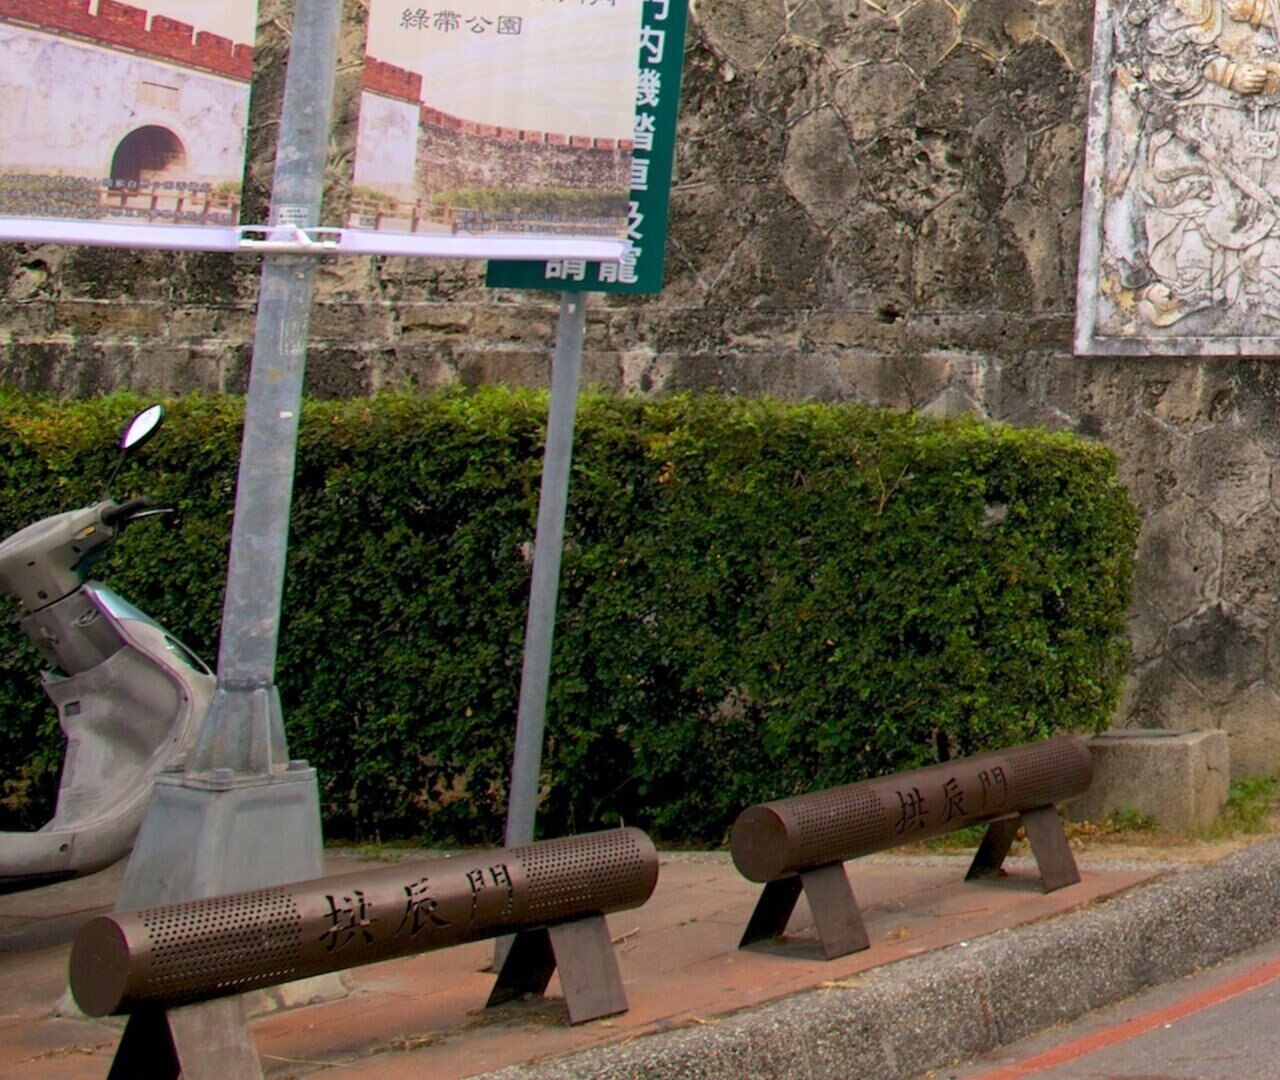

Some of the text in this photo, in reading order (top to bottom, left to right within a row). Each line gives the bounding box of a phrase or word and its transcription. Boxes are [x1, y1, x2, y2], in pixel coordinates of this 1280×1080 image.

[399, 7, 523, 35] 綠帶公園
[894, 765, 1009, 835] 拱辰門
[318, 862, 515, 954] 拱辰門
